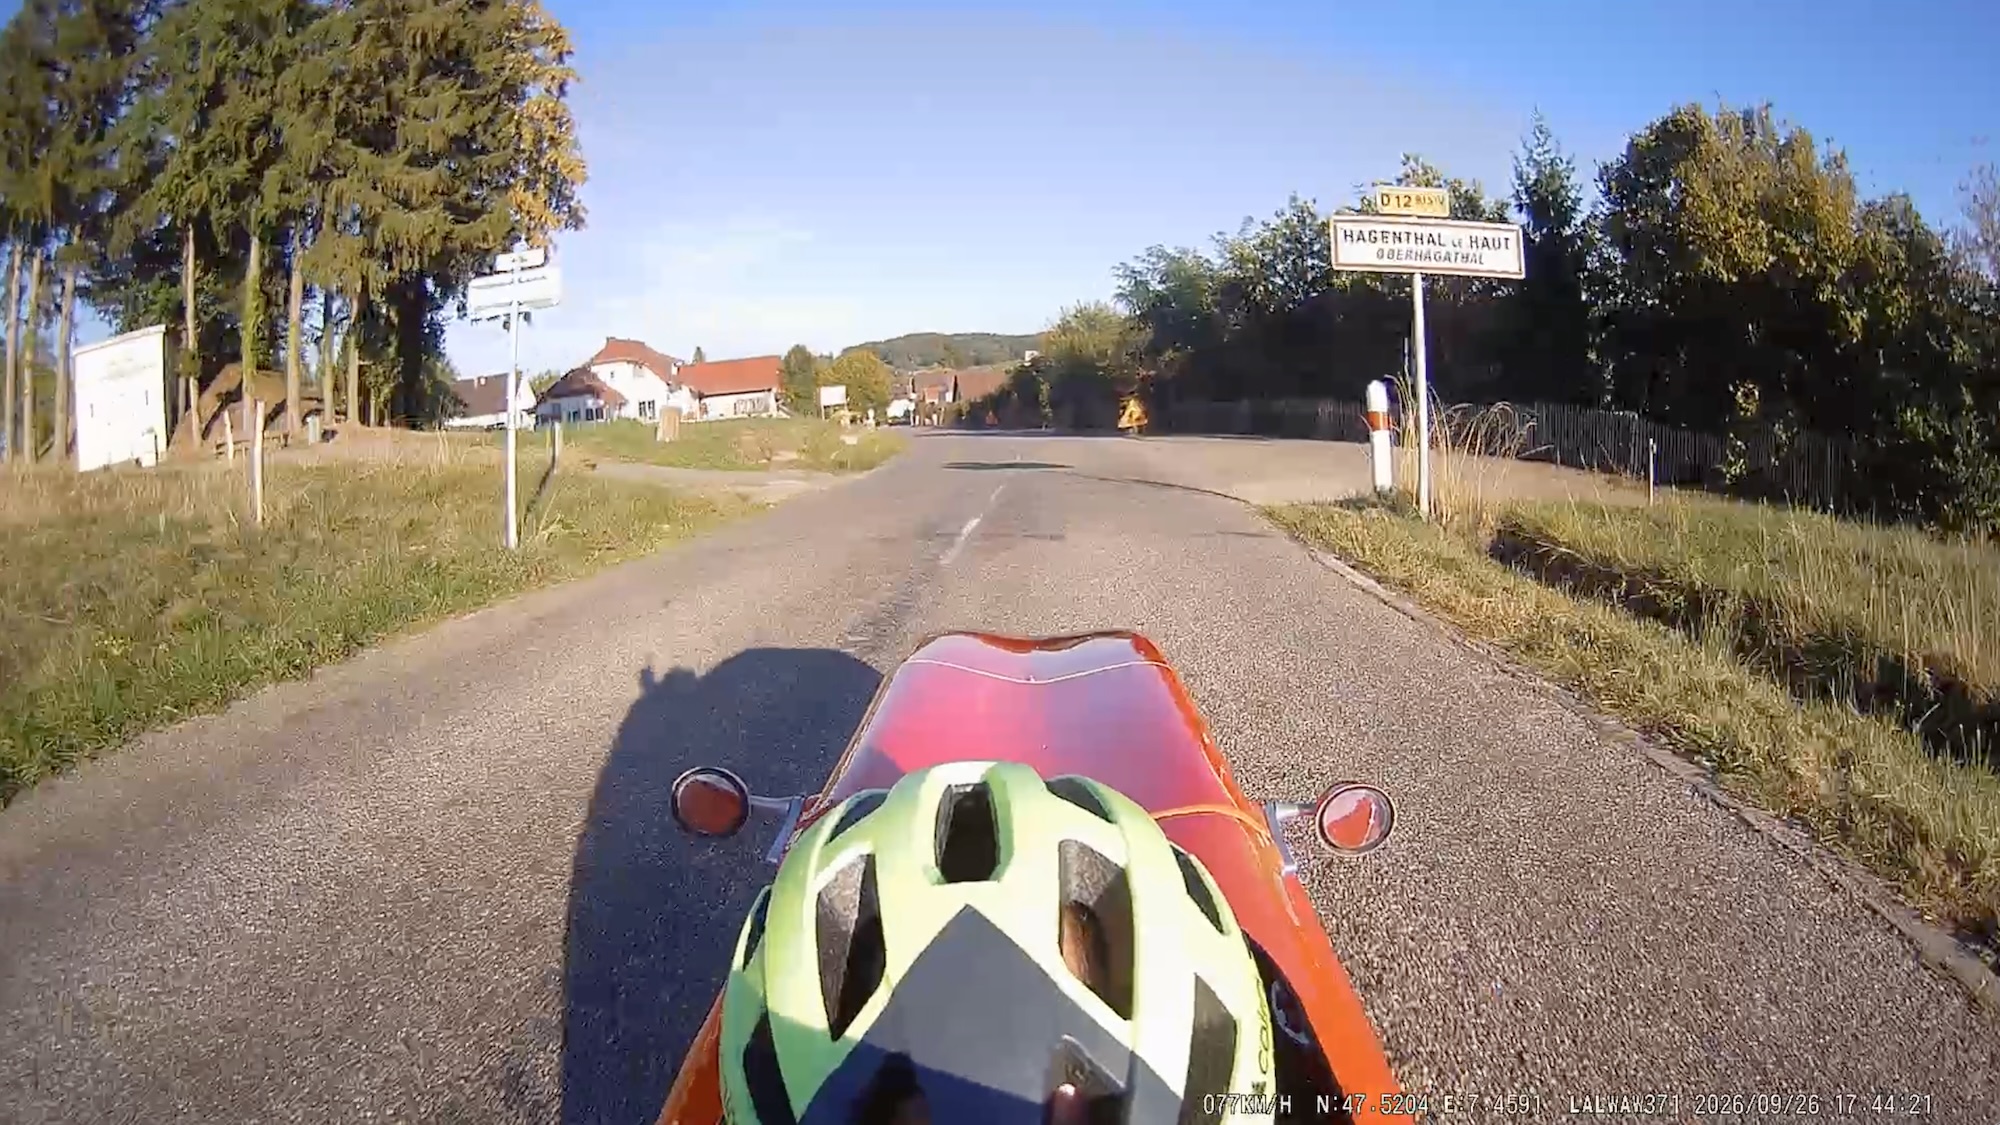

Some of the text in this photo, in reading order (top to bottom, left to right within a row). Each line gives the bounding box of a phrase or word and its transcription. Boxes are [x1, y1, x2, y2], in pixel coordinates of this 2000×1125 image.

[1381, 192, 1391, 207] D
[1395, 194, 1412, 208] 12
[1343, 229, 1447, 247] HAGENTHAL
[1469, 235, 1511, 250] HAUT
[1376, 248, 1485, 265] OBERHAGATHAL
